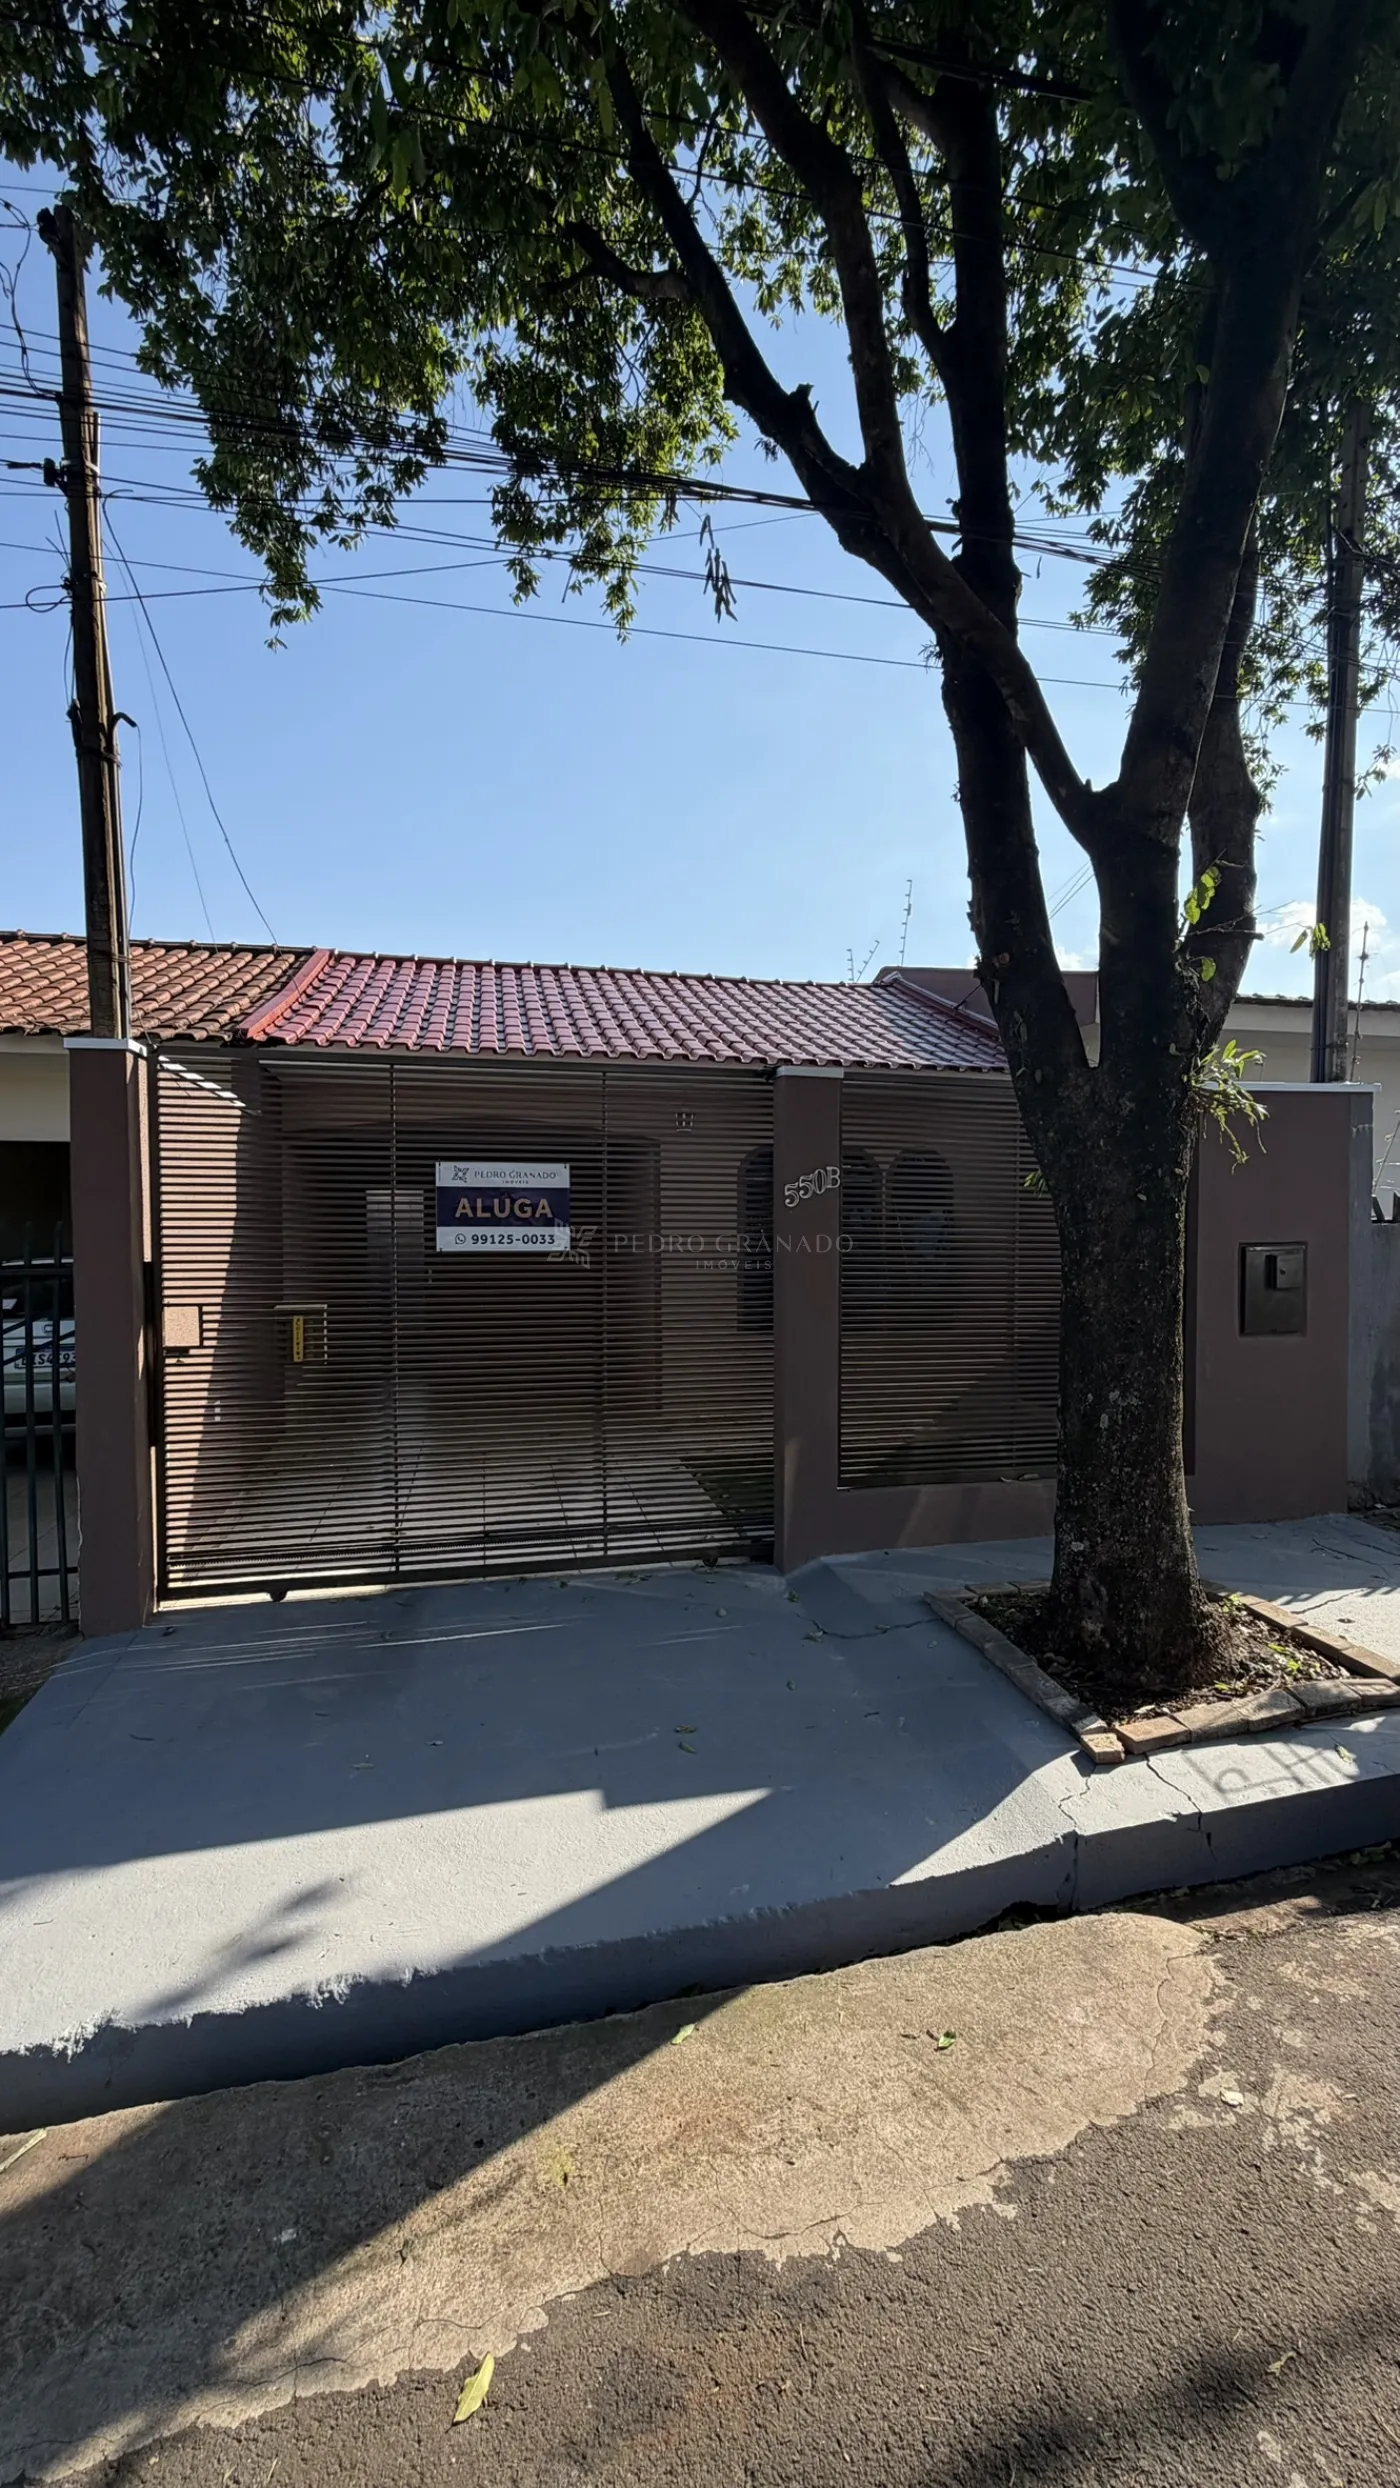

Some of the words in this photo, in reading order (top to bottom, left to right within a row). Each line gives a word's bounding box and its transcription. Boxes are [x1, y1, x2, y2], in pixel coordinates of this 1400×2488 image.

[474, 1170, 506, 1179] PEDRO
[508, 1170, 557, 1180] GRANADO
[784, 1166, 841, 1207] 550B
[455, 1197, 553, 1218] ALUGA
[471, 1233, 555, 1245] 99125-0033
